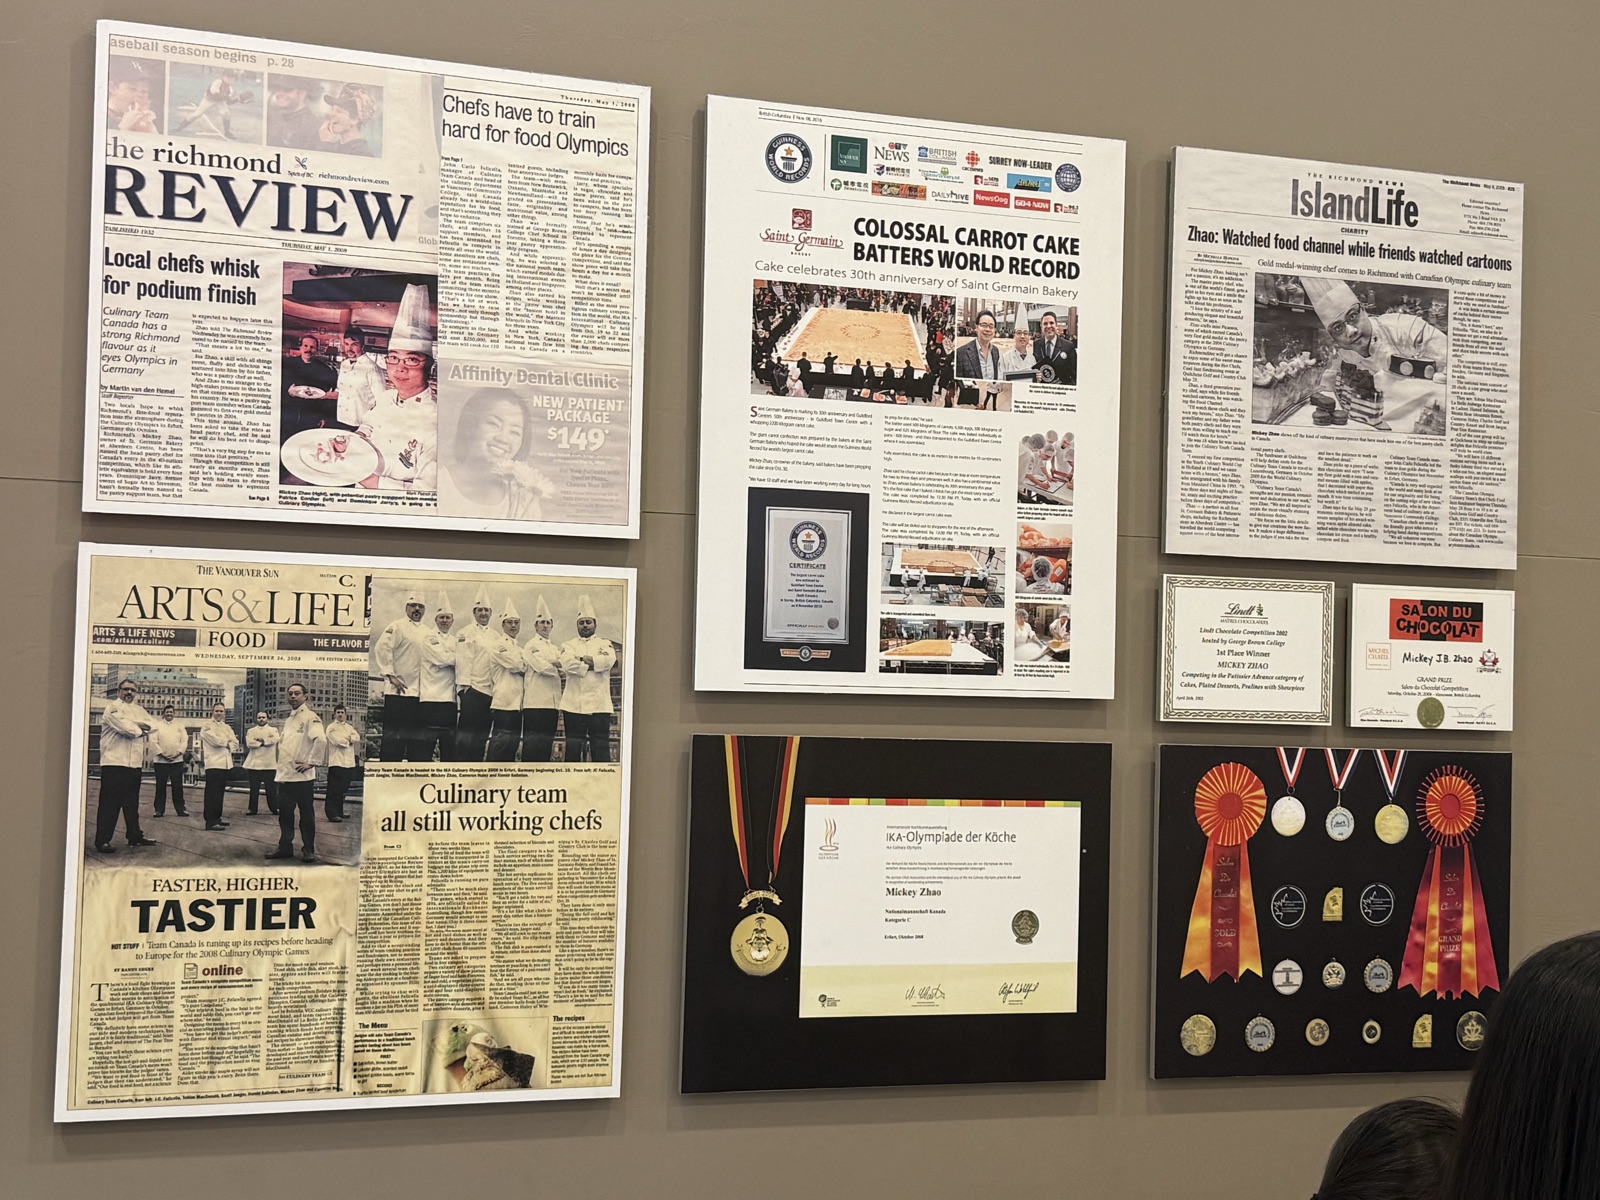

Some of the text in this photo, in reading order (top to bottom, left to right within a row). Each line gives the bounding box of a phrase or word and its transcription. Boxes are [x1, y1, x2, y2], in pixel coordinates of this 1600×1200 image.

[163, 41, 210, 59] season
[214, 48, 257, 65] begins
[267, 57, 278, 69] p.
[281, 57, 294, 68] 28
[443, 94, 596, 129] Chefs have to train
[442, 119, 629, 157] hard for food Olympics
[107, 137, 144, 160] the
[153, 142, 281, 175] richmond
[768, 137, 810, 180] GUINNESS WORLD RECORDS
[874, 146, 909, 162] NEWS
[989, 156, 1052, 170] SURREY NOW-LEADER
[1328, 174, 1374, 184] RICHMOND
[105, 164, 414, 242] REVIEW
[976, 194, 1008, 205] NewsDog
[1291, 178, 1419, 228] IslandLife
[854, 217, 1080, 256] COLOSSAL CARROT CAKE
[1340, 227, 1368, 236] CHARITY
[759, 228, 844, 252] Saint Germain
[1188, 225, 1512, 271] Zhao: Watched food channel while friends watched cartoons
[104, 247, 260, 278] Local chefs whisk
[853, 242, 1080, 280] BATTERS WORLD RECORD
[755, 260, 1079, 300] Cake celebrates 30th anniversary of Saint Germain Bakery
[1258, 259, 1274, 267] Gold
[1275, 261, 1322, 273] medal-winning
[1323, 264, 1337, 273] chef
[1338, 266, 1358, 275] comes
[1367, 269, 1398, 278] Richmond
[1400, 272, 1414, 280] with
[1415, 273, 1443, 283] Canadian
[1445, 275, 1470, 286] Olympic
[1472, 279, 1495, 289] culinary
[103, 275, 256, 306] for podium finish
[103, 306, 169, 320] Culinary Team
[103, 318, 139, 329] Canada
[142, 321, 158, 330] has
[102, 330, 180, 343] strong Richmond
[102, 341, 133, 351] flavour
[102, 354, 177, 366] eyes Olympics in
[102, 364, 144, 377] Germany
[450, 365, 619, 389] Affinity Dental Clinic
[533, 395, 625, 412] NEW PATIENT
[547, 409, 610, 424] PACKAGE
[196, 565, 279, 578] THE VANCOUVER SUN
[116, 584, 355, 628] ARTS&LIFE
[1224, 603, 1256, 616] Lindt
[1401, 604, 1472, 618] SALON DU
[1396, 618, 1480, 638] CHOCOLAT
[208, 631, 267, 648] FOOD
[313, 638, 363, 648] THE FLAVOR
[1402, 652, 1434, 666] Mickey
[419, 782, 567, 809] Culinary team
[381, 809, 602, 836] all still working chefs
[886, 831, 1016, 845] IKA-Olympiade der Köche
[152, 877, 299, 893] FASTER, HIGHER,
[885, 887, 942, 898] Mickey Zhao
[130, 897, 317, 934] TASTIER
[1214, 929, 1236, 937] GOLD
[148, 941, 167, 950] Team
[169, 940, 197, 949] Canada
[206, 940, 231, 950] tuning
[232, 940, 242, 948] up
[254, 939, 280, 949] recipes
[281, 937, 303, 946] before
[305, 937, 334, 947] heading
[146, 951, 171, 961] Europe
[172, 950, 184, 959] for
[199, 950, 218, 958] 2008
[219, 949, 251, 960] Culinary
[252, 948, 283, 958] Olympic
[202, 964, 243, 977] online
